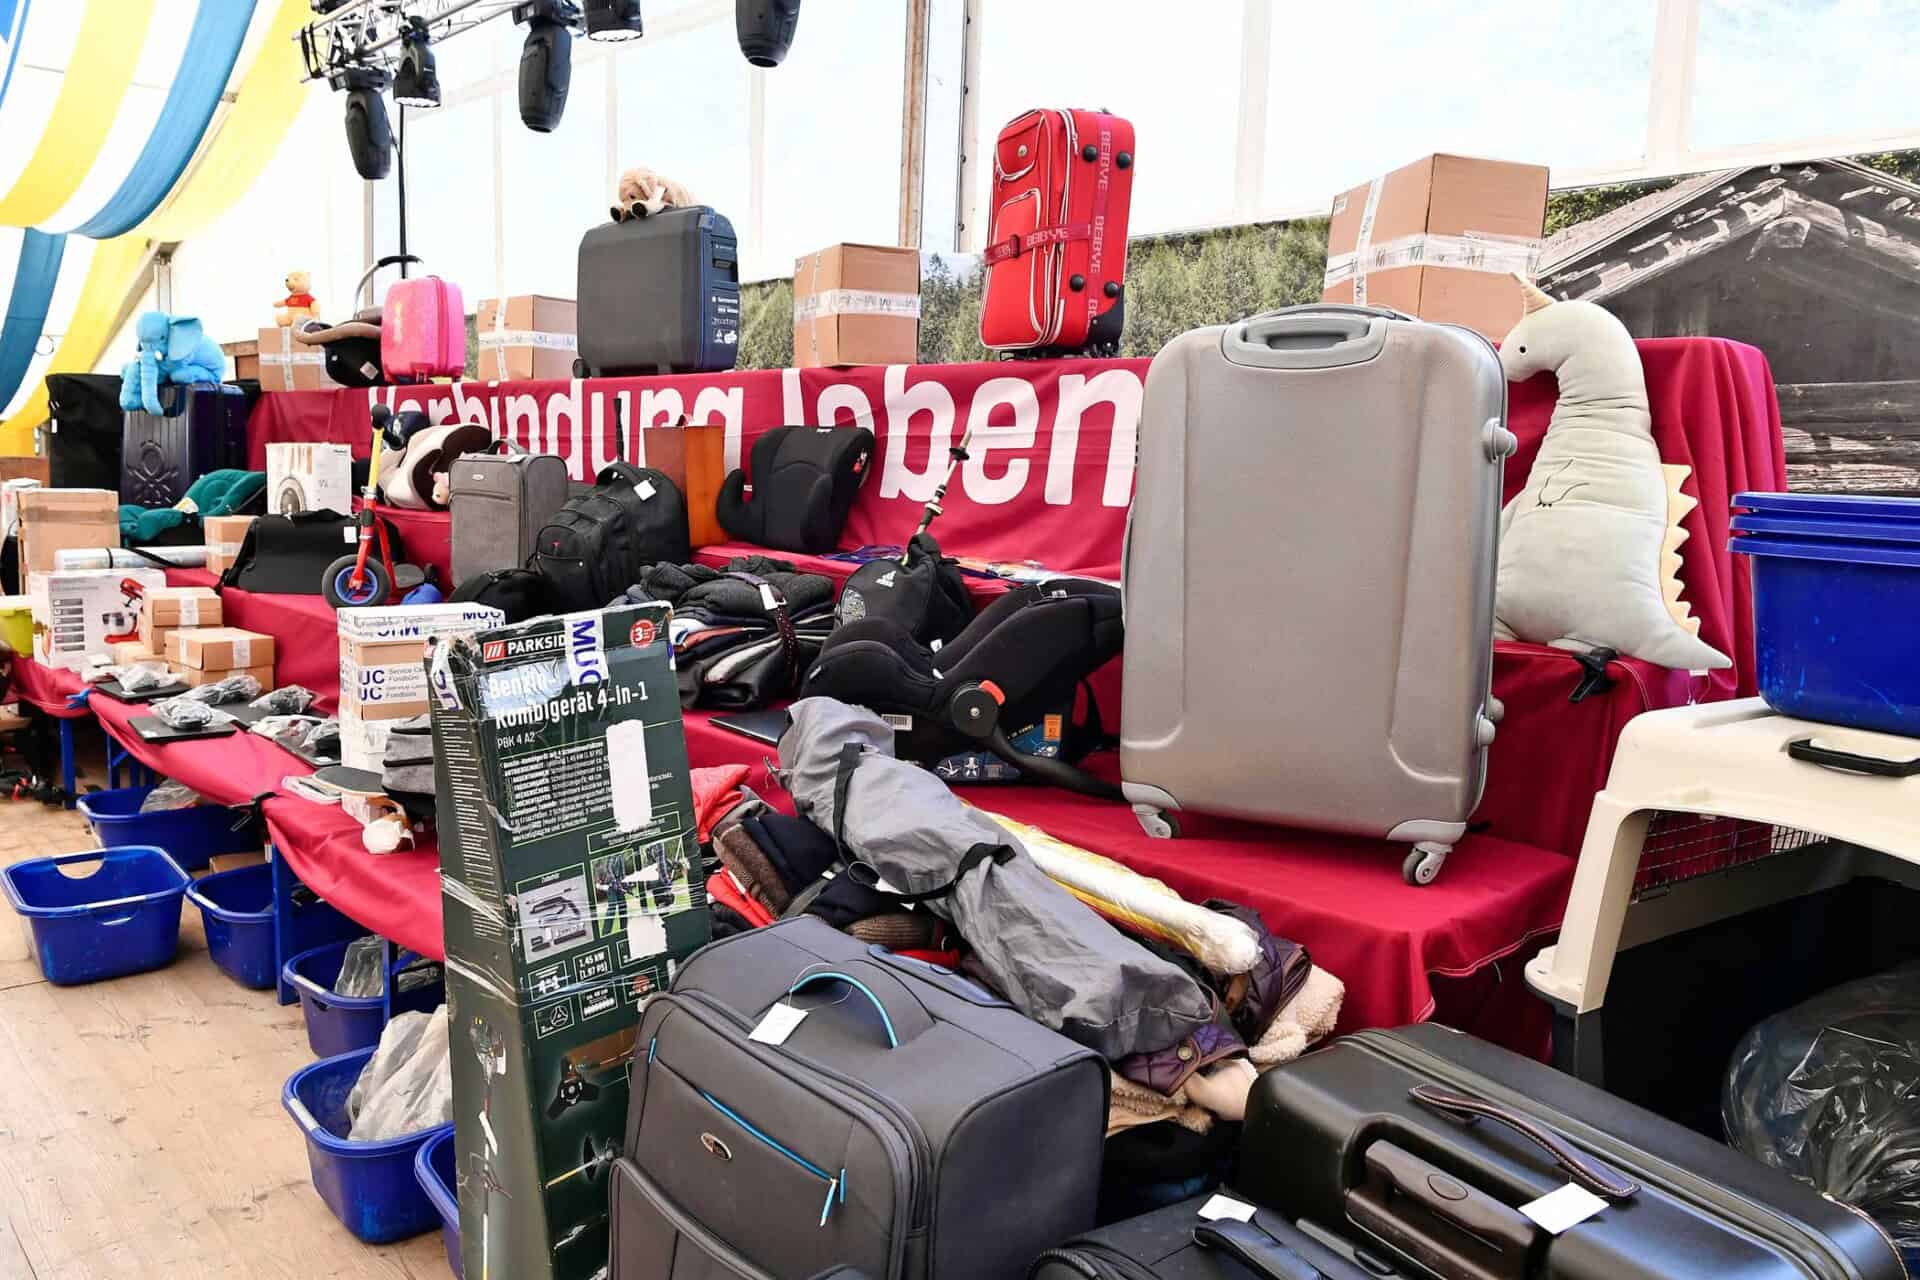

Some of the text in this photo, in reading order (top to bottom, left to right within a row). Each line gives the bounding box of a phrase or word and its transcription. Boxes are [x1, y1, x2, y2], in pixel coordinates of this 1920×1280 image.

[508, 634, 566, 656] PARKSID
[495, 681, 649, 729] Kombigerät 4-in-1
[516, 733, 522, 745] 4
